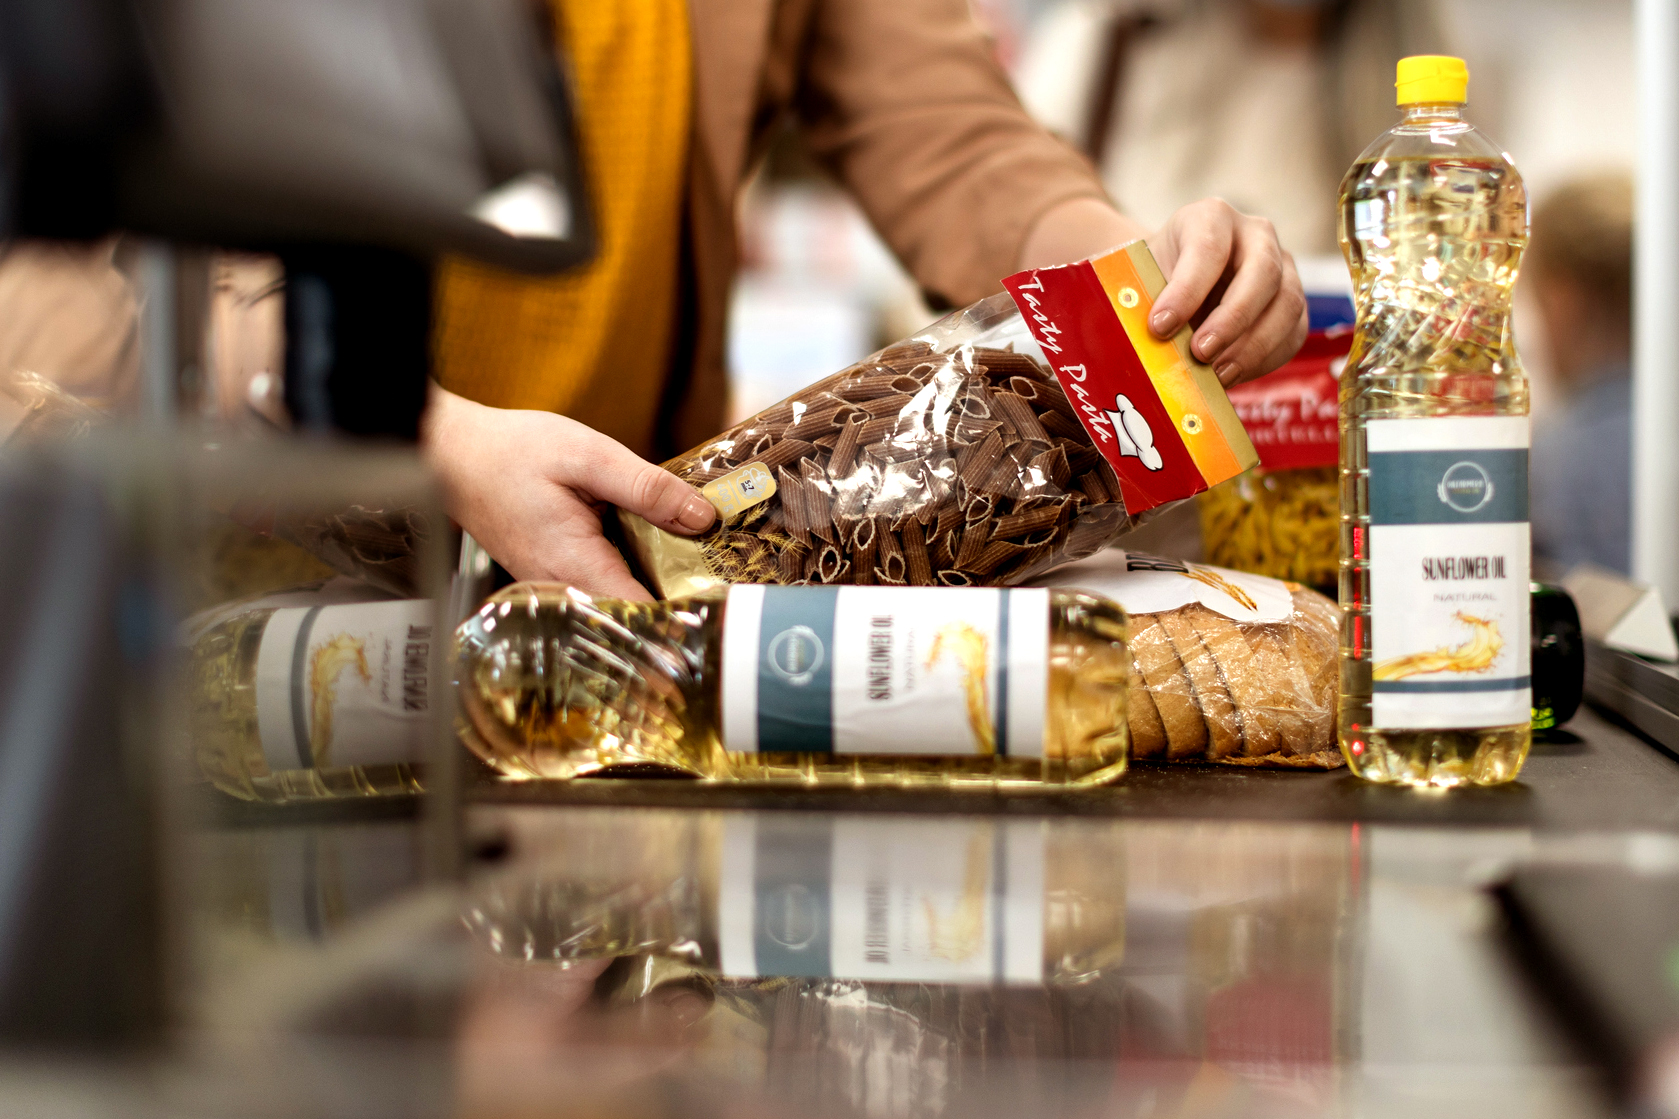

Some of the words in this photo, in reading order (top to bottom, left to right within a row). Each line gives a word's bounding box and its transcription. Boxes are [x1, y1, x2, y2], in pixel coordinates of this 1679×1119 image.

[1018, 277, 1062, 354] Tasty
[1059, 364, 1112, 443] Pasta
[717, 484, 731, 502] 400
[1422, 556, 1488, 580] SUNFLOWER
[1491, 556, 1507, 579] OIL
[1433, 592, 1497, 602] NATURAL
[869, 631, 894, 700] SUNFLOWER
